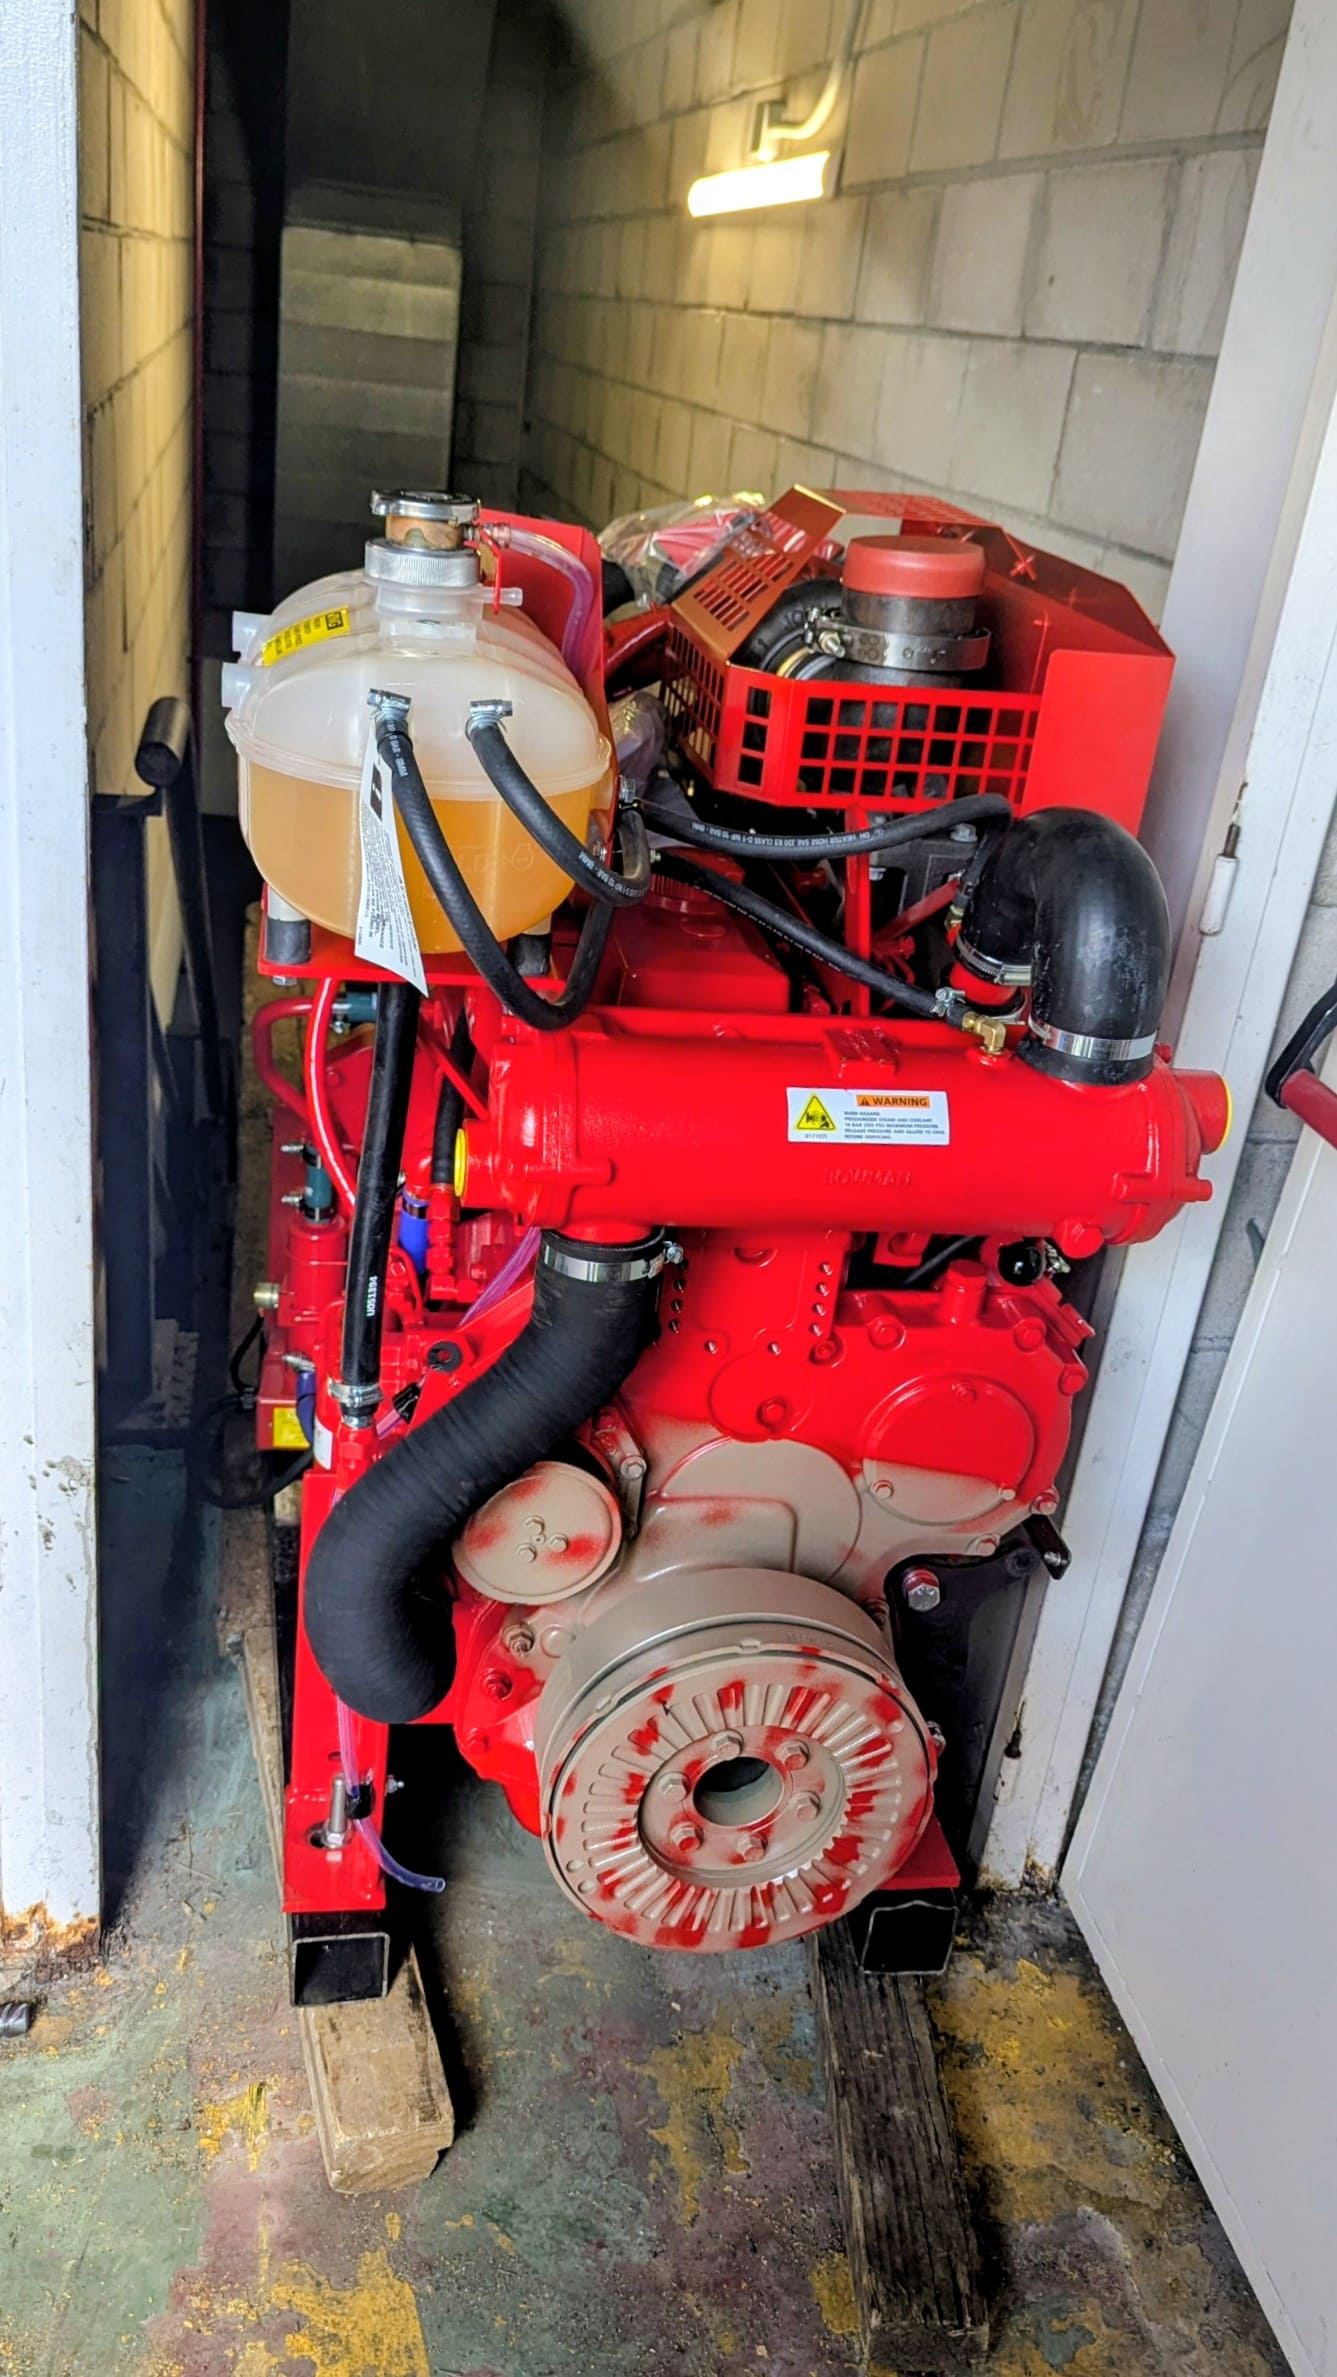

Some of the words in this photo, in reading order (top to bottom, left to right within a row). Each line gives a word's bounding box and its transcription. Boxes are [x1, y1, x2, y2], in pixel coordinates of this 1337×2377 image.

[754, 836, 773, 846] CLASS
[811, 838, 829, 846] HOSE
[830, 834, 857, 844] HEATER
[873, 1097, 928, 1107] WARNING
